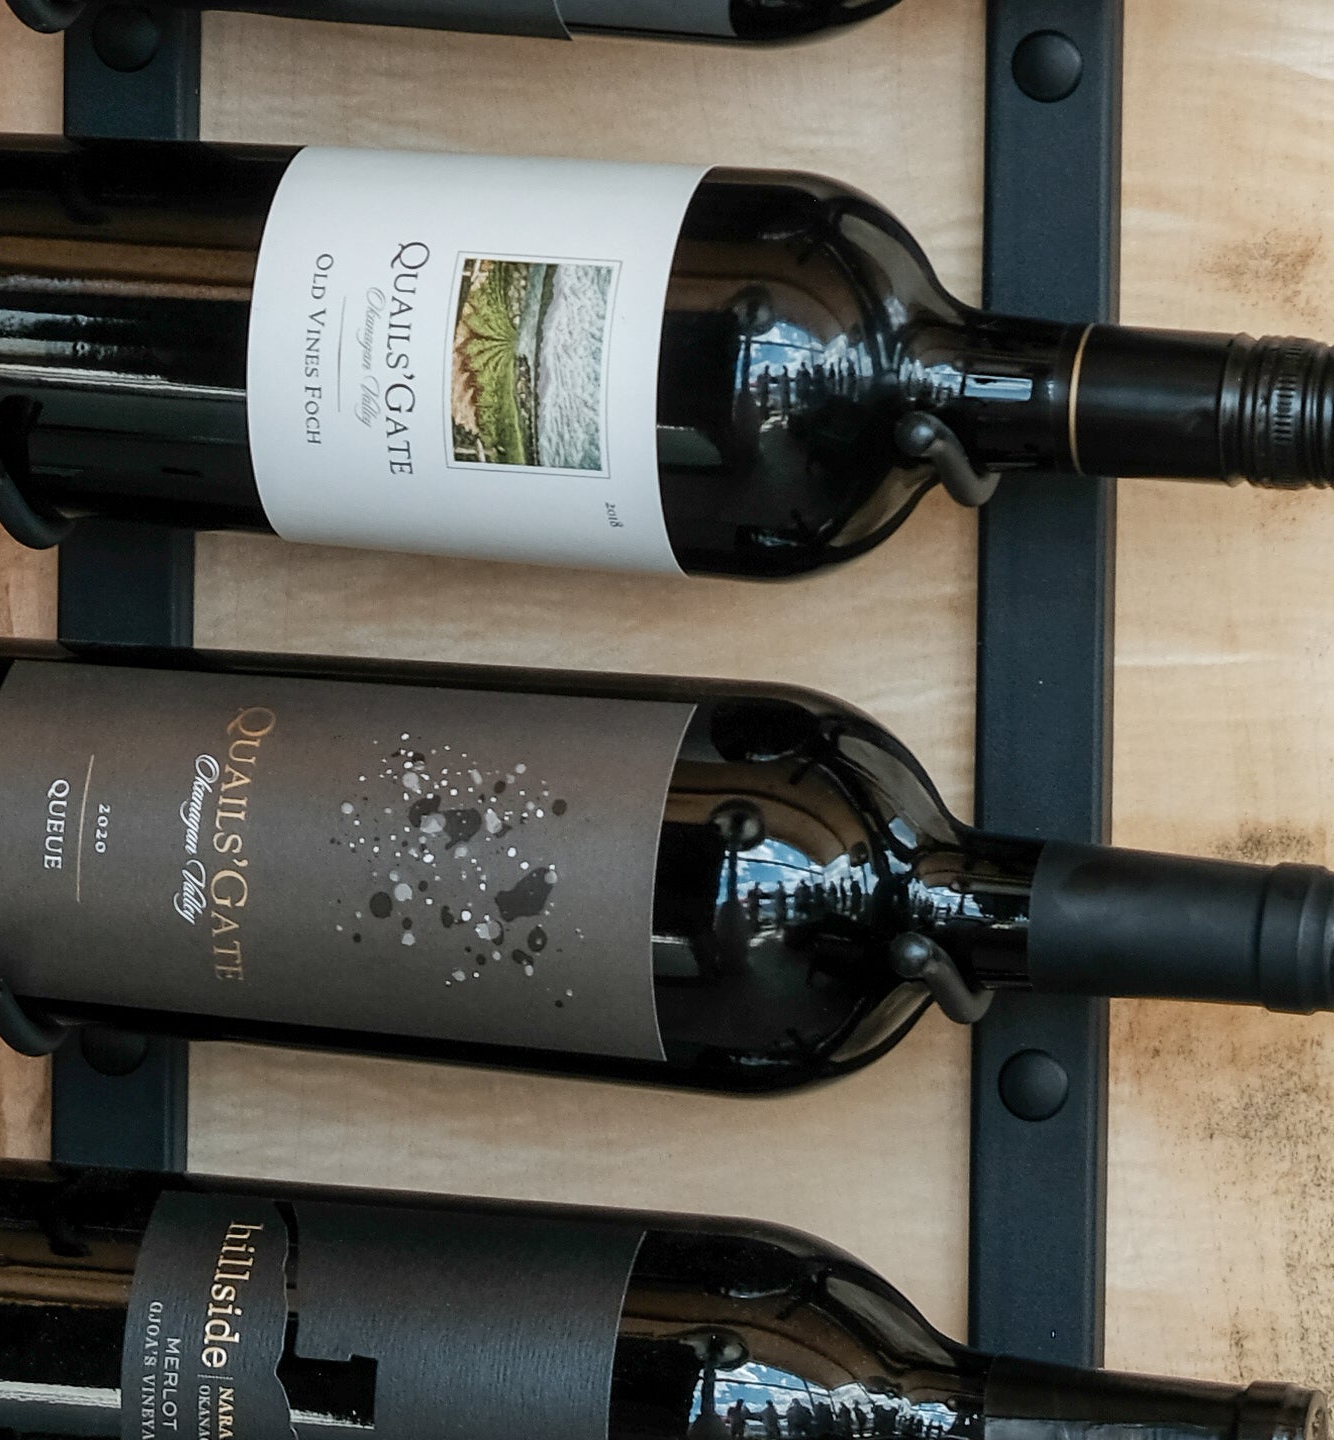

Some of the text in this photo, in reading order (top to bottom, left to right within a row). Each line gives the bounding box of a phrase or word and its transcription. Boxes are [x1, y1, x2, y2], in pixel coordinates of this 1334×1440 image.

[304, 253, 335, 446] OLD VINES FOCH
[354, 286, 386, 428] Okanagan Valley
[605, 502, 624, 528] 2018
[44, 779, 70, 870] QUEUE
[95, 803, 112, 855] 2020
[173, 753, 221, 925] Okanagan Valley
[143, 1300, 164, 1368] GJOA'S
[202, 1220, 264, 1369] hillside
[162, 1336, 182, 1431] MERLOT
